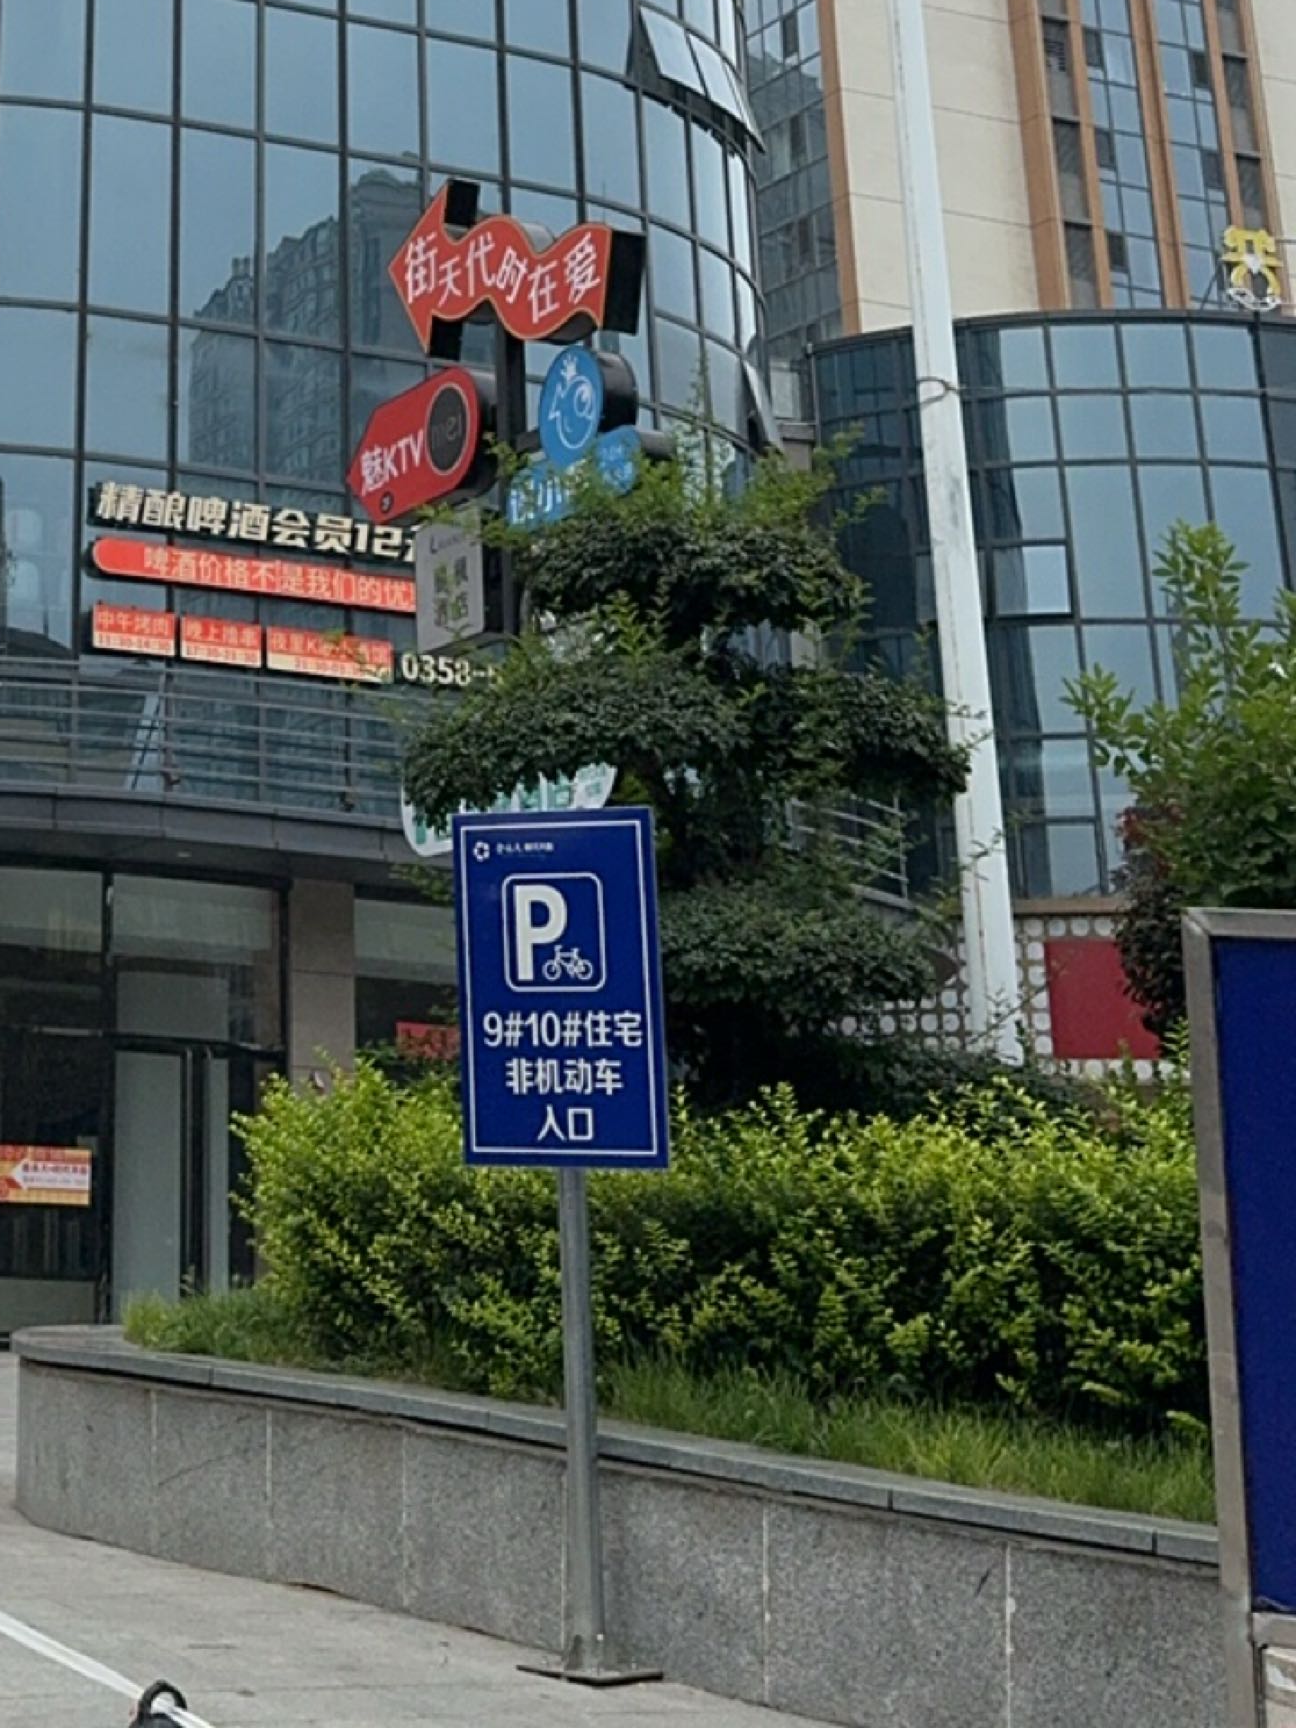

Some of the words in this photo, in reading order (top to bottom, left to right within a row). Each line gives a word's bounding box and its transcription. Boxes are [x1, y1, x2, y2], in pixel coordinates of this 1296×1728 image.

[96, 481, 416, 563] 精酿啤酒会员12
[513, 884, 568, 982] P
[482, 1010, 643, 1048] 9#10#住宅
[505, 1057, 624, 1096] 非机动车
[537, 1104, 594, 1142] 入口
